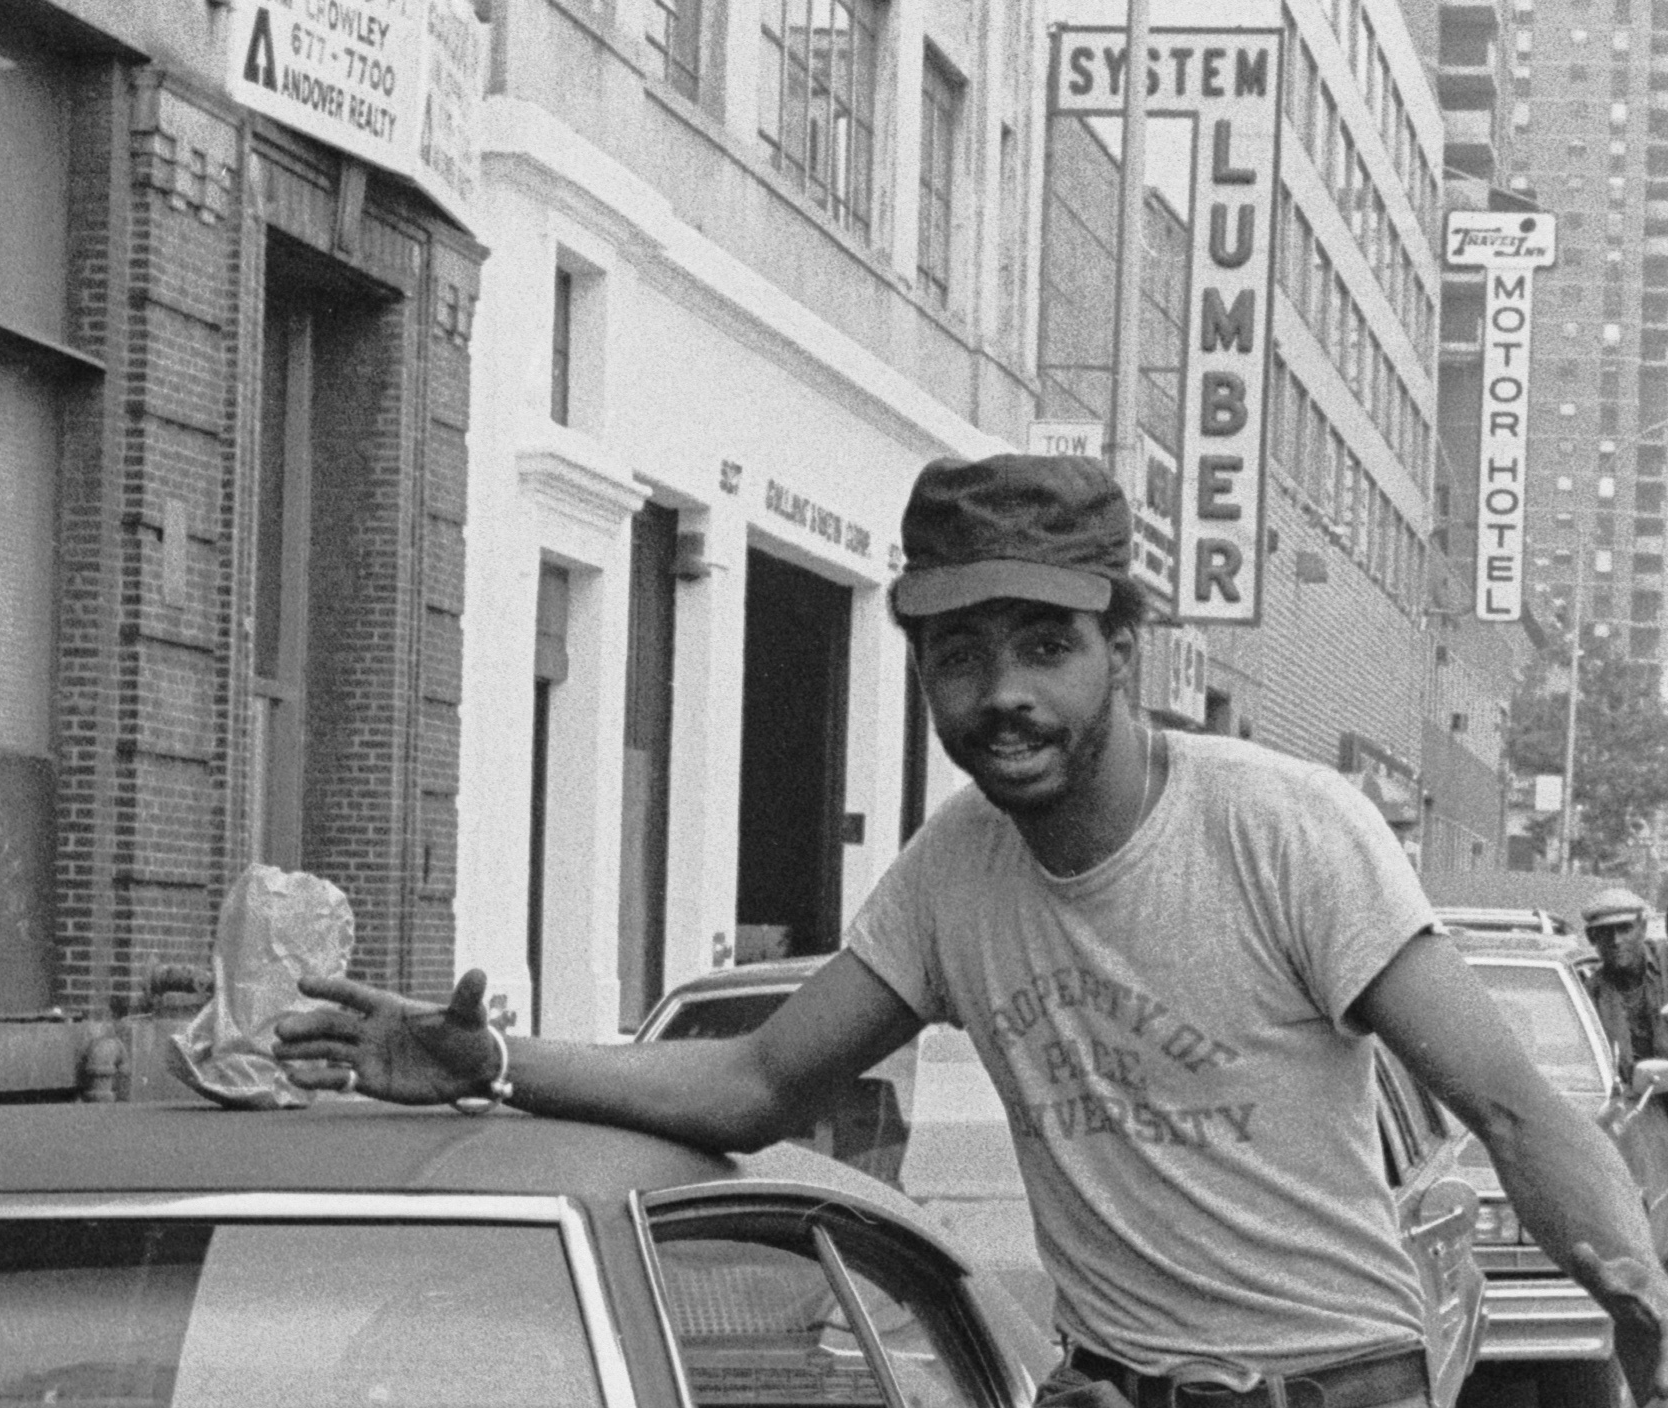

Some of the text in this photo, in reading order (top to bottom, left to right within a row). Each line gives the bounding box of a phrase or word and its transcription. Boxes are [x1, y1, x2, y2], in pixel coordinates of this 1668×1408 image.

[281, 64, 397, 142] ANDOVER REALTY
[1068, 46, 1269, 98] SYSTEM
[1194, 118, 1257, 604] LUMBER
[1043, 435, 1088, 455] TOW
[1485, 275, 1526, 615] MOTOR HOTEL
[1161, 1023, 1240, 1074] OF
